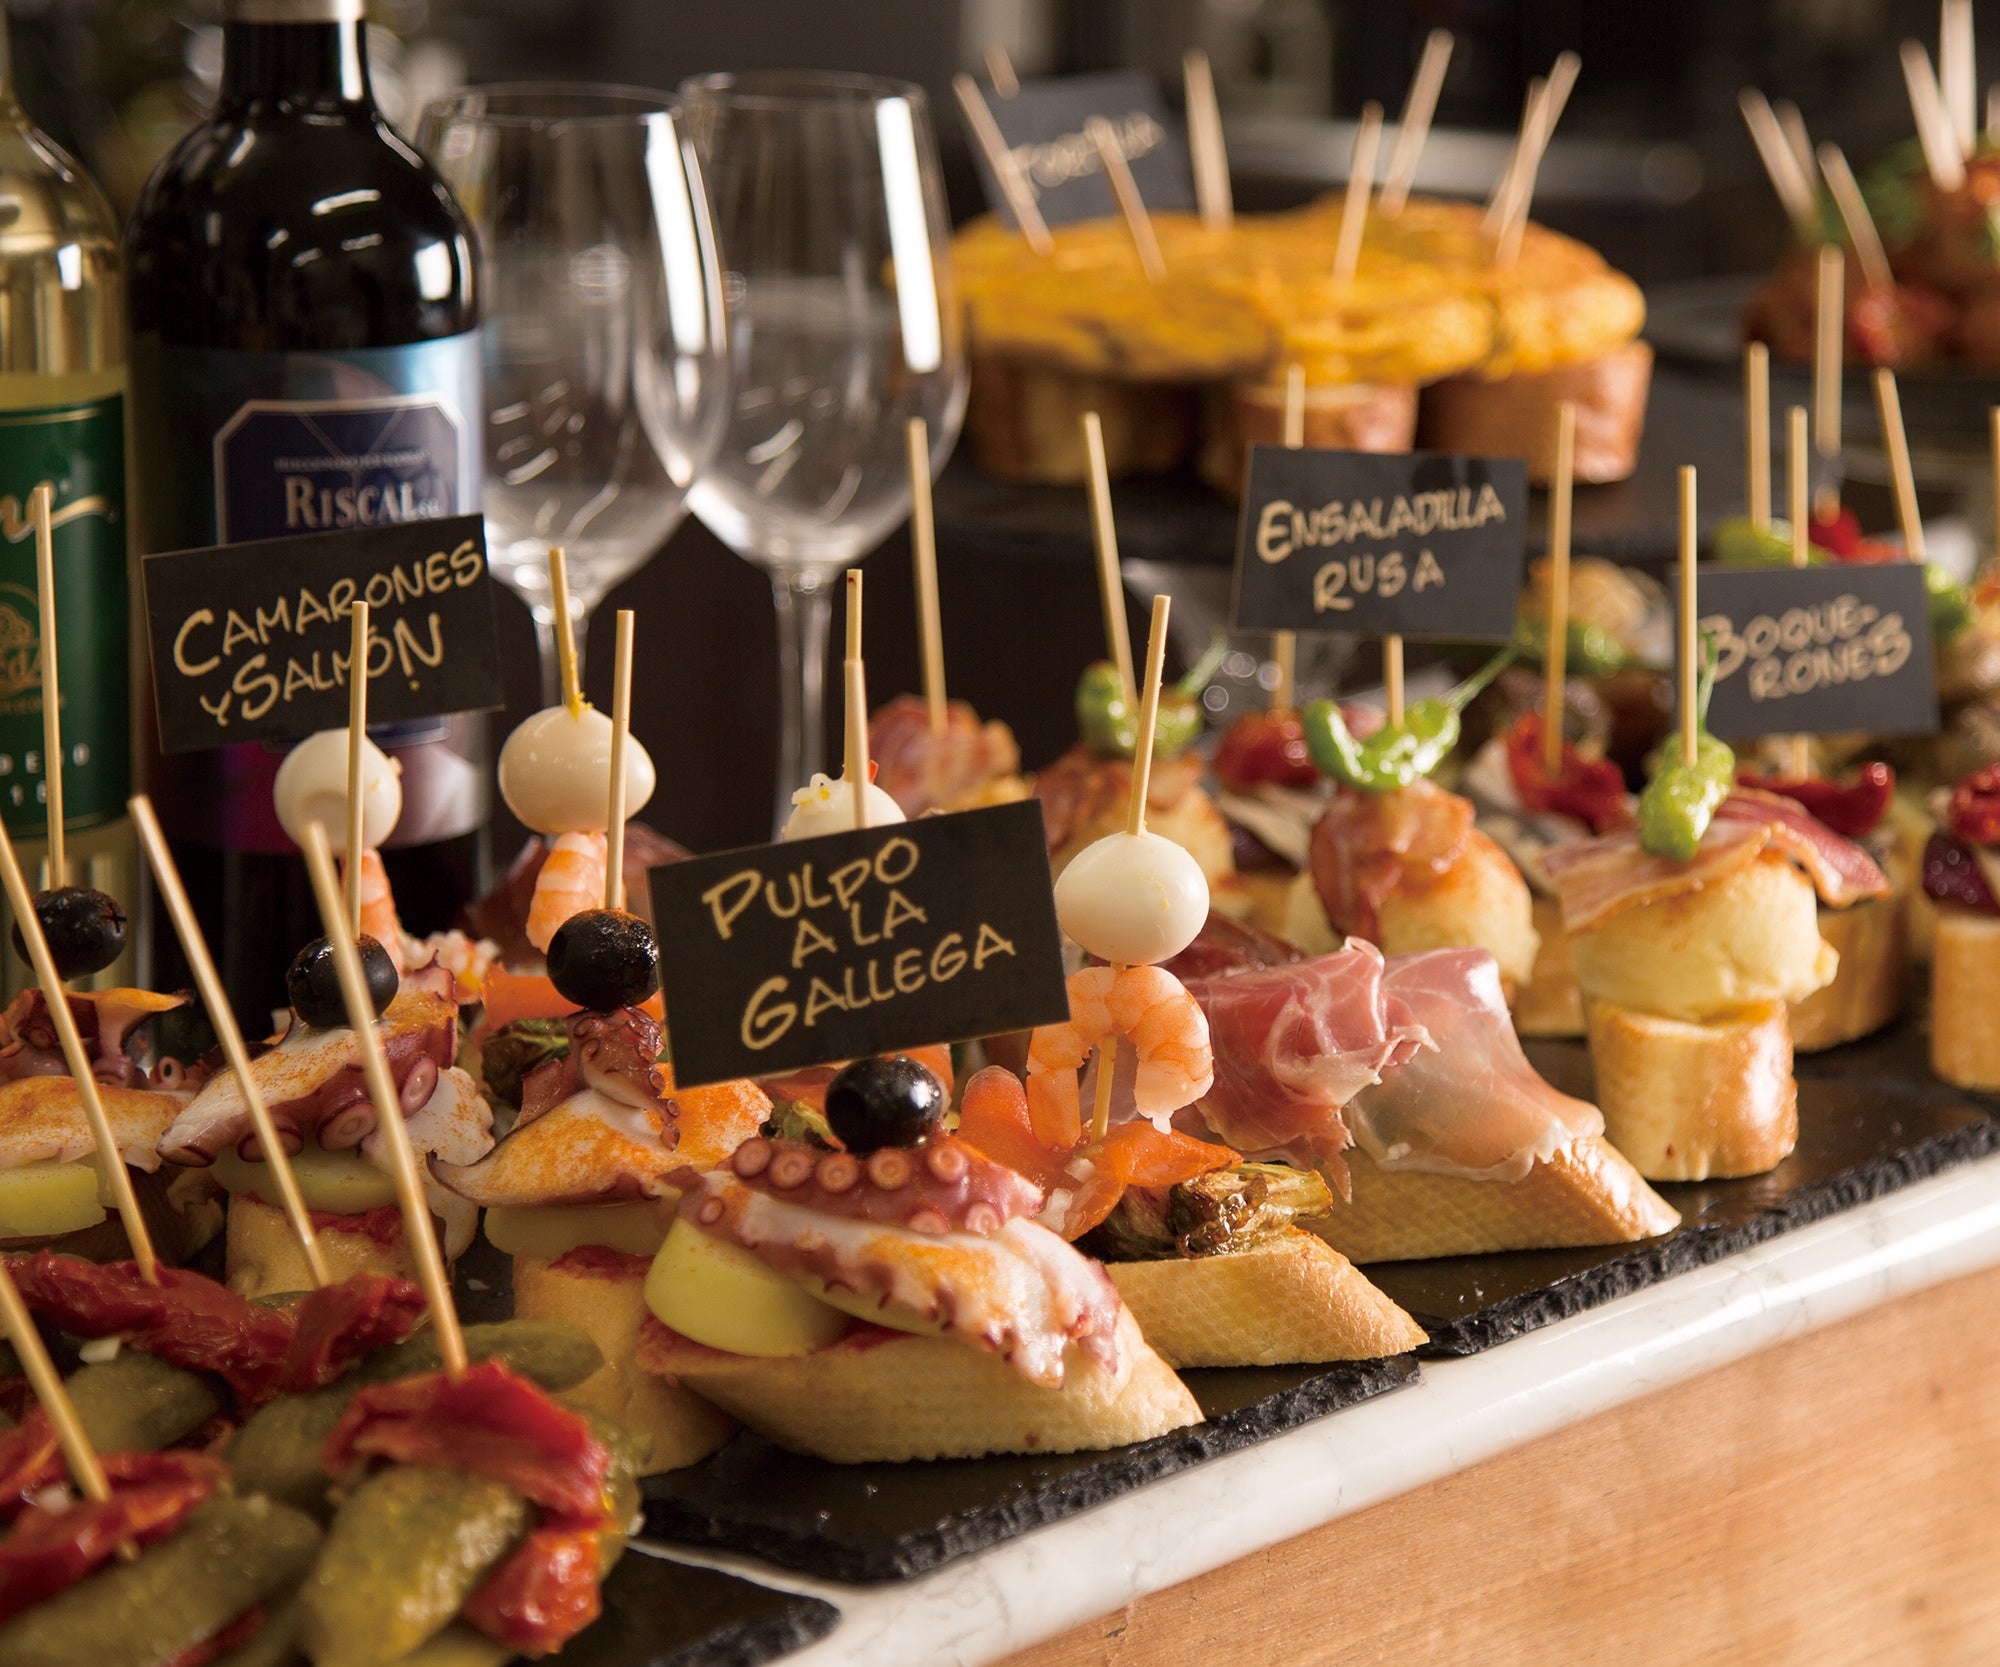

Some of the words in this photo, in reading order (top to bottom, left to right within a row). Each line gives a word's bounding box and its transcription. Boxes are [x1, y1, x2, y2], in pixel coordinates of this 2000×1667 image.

[285, 475, 418, 529] RISCAL
[1256, 483, 1506, 564] ENSALADILLA
[173, 539, 484, 676] CAMARONES
[1313, 549, 1446, 613] RUSA
[1748, 611, 1912, 703] RONES
[702, 837, 919, 940] PULPO
[791, 918, 839, 969] A
[850, 889, 928, 947] LA
[741, 922, 1017, 1051] GALLEGA
